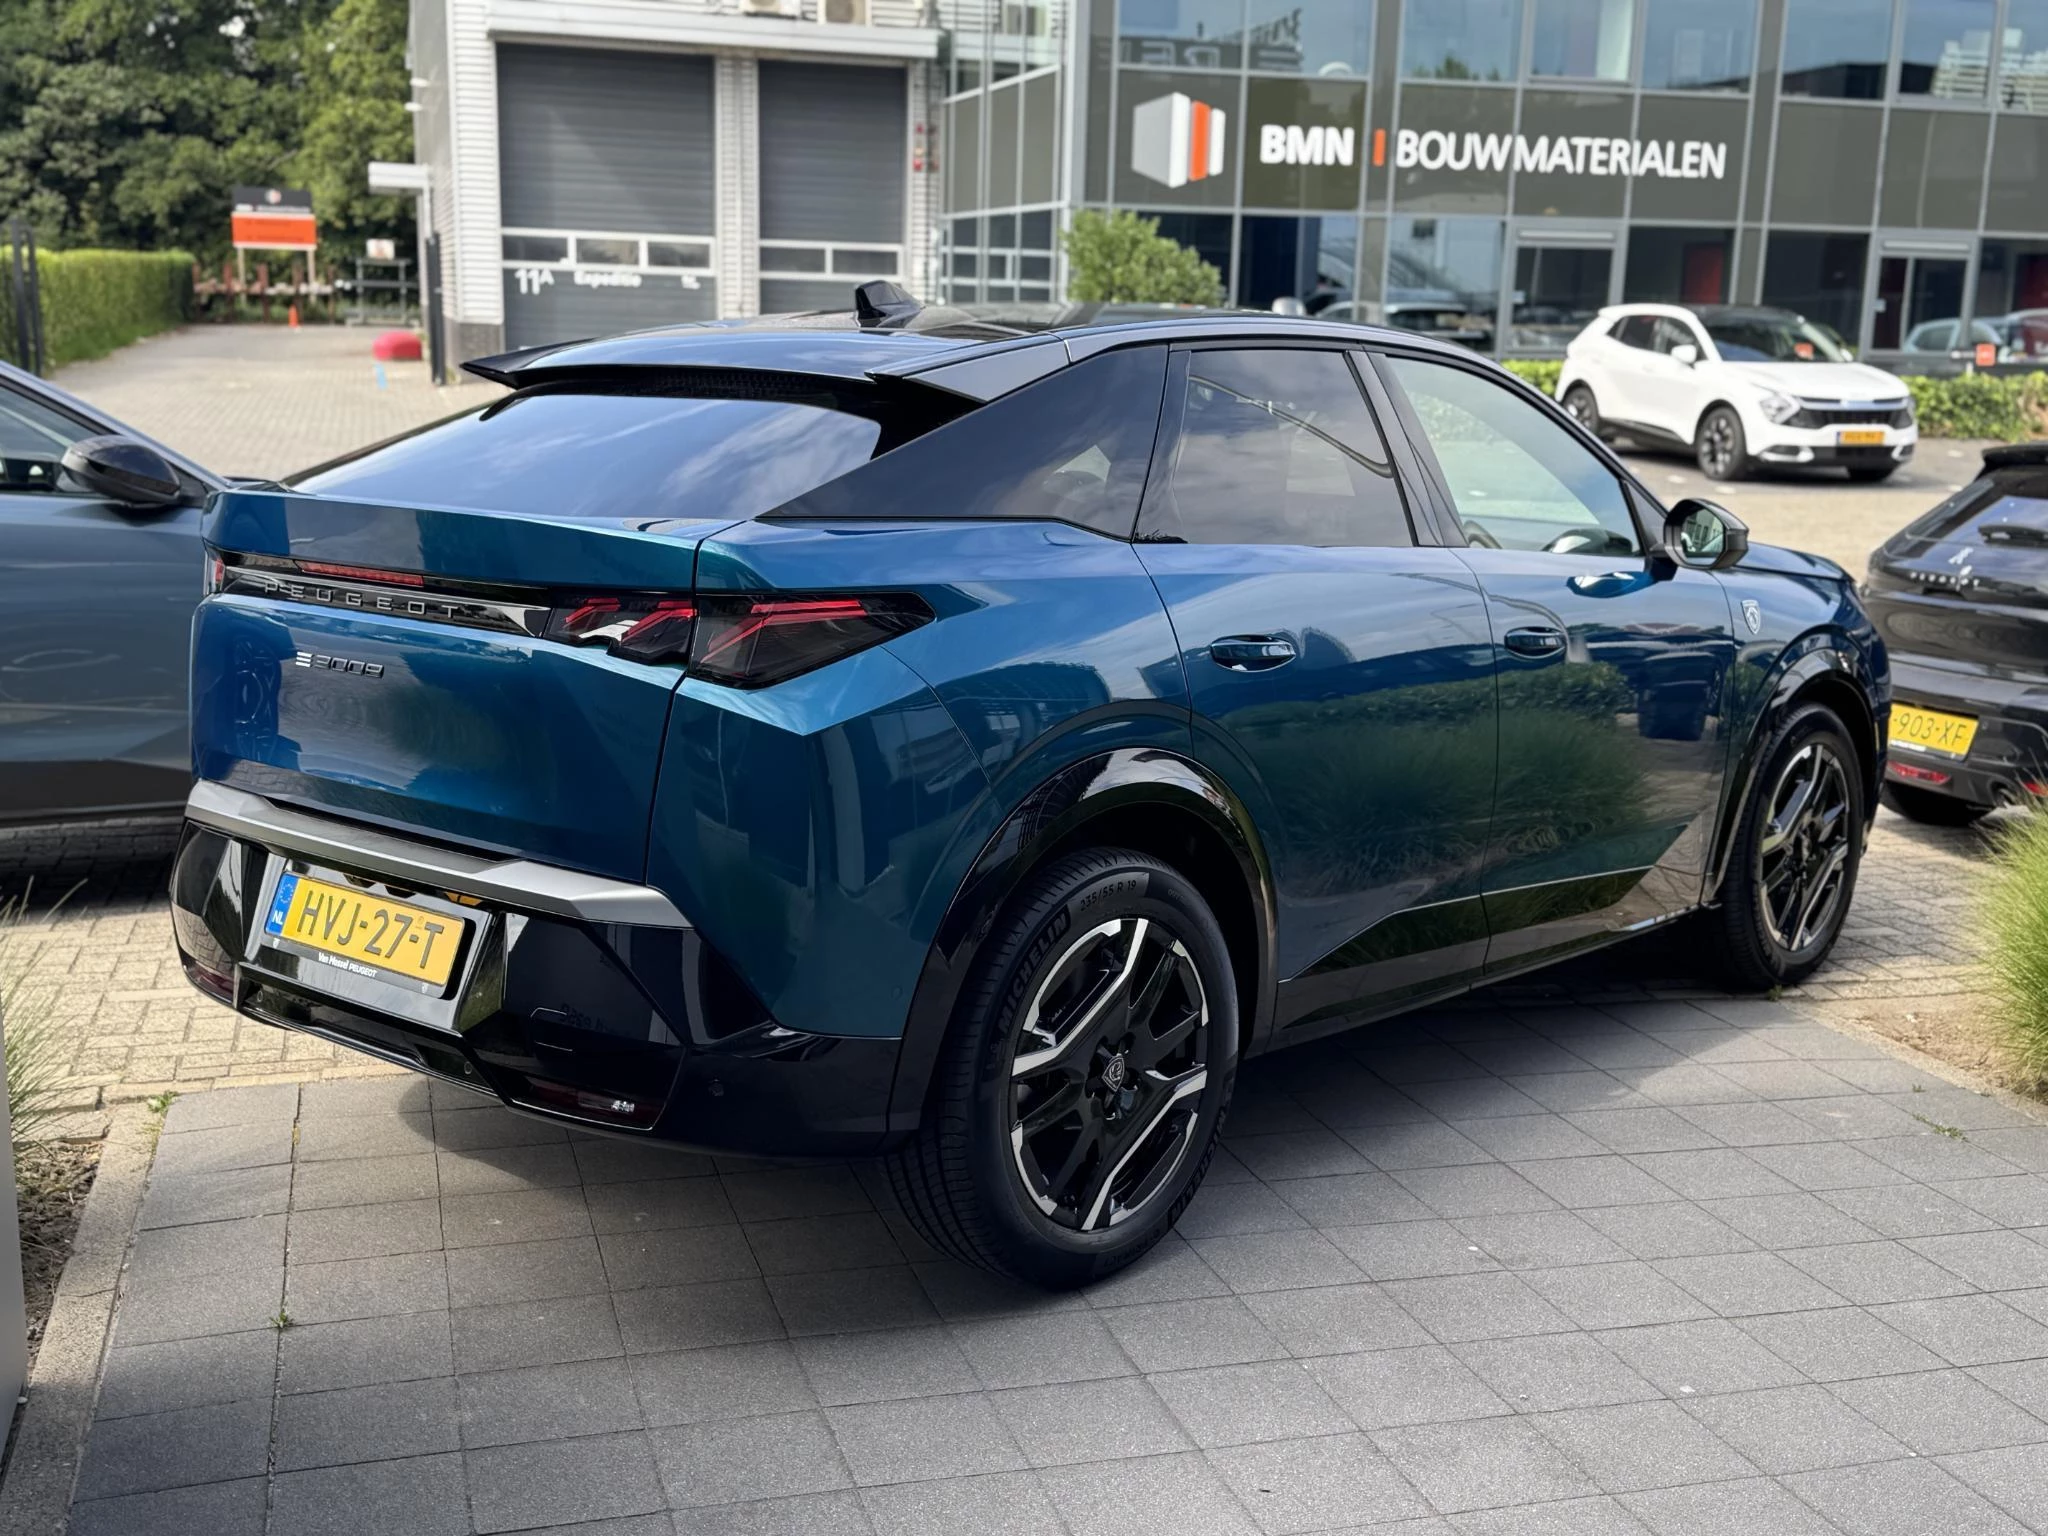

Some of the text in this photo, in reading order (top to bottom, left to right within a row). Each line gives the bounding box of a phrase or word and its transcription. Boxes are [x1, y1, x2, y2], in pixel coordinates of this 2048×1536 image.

[1260, 124, 1727, 180] BMN BOUWMATERIALEN
[264, 583, 458, 618] PEUGEOT
[1893, 712, 1967, 746] -903-XF
[1128, 880, 1137, 891] 19
[272, 910, 284, 925] NL
[297, 890, 445, 969] HVJ-27-T
[349, 963, 378, 978] PEUGEOT
[997, 911, 1068, 1034] MICHELIN
